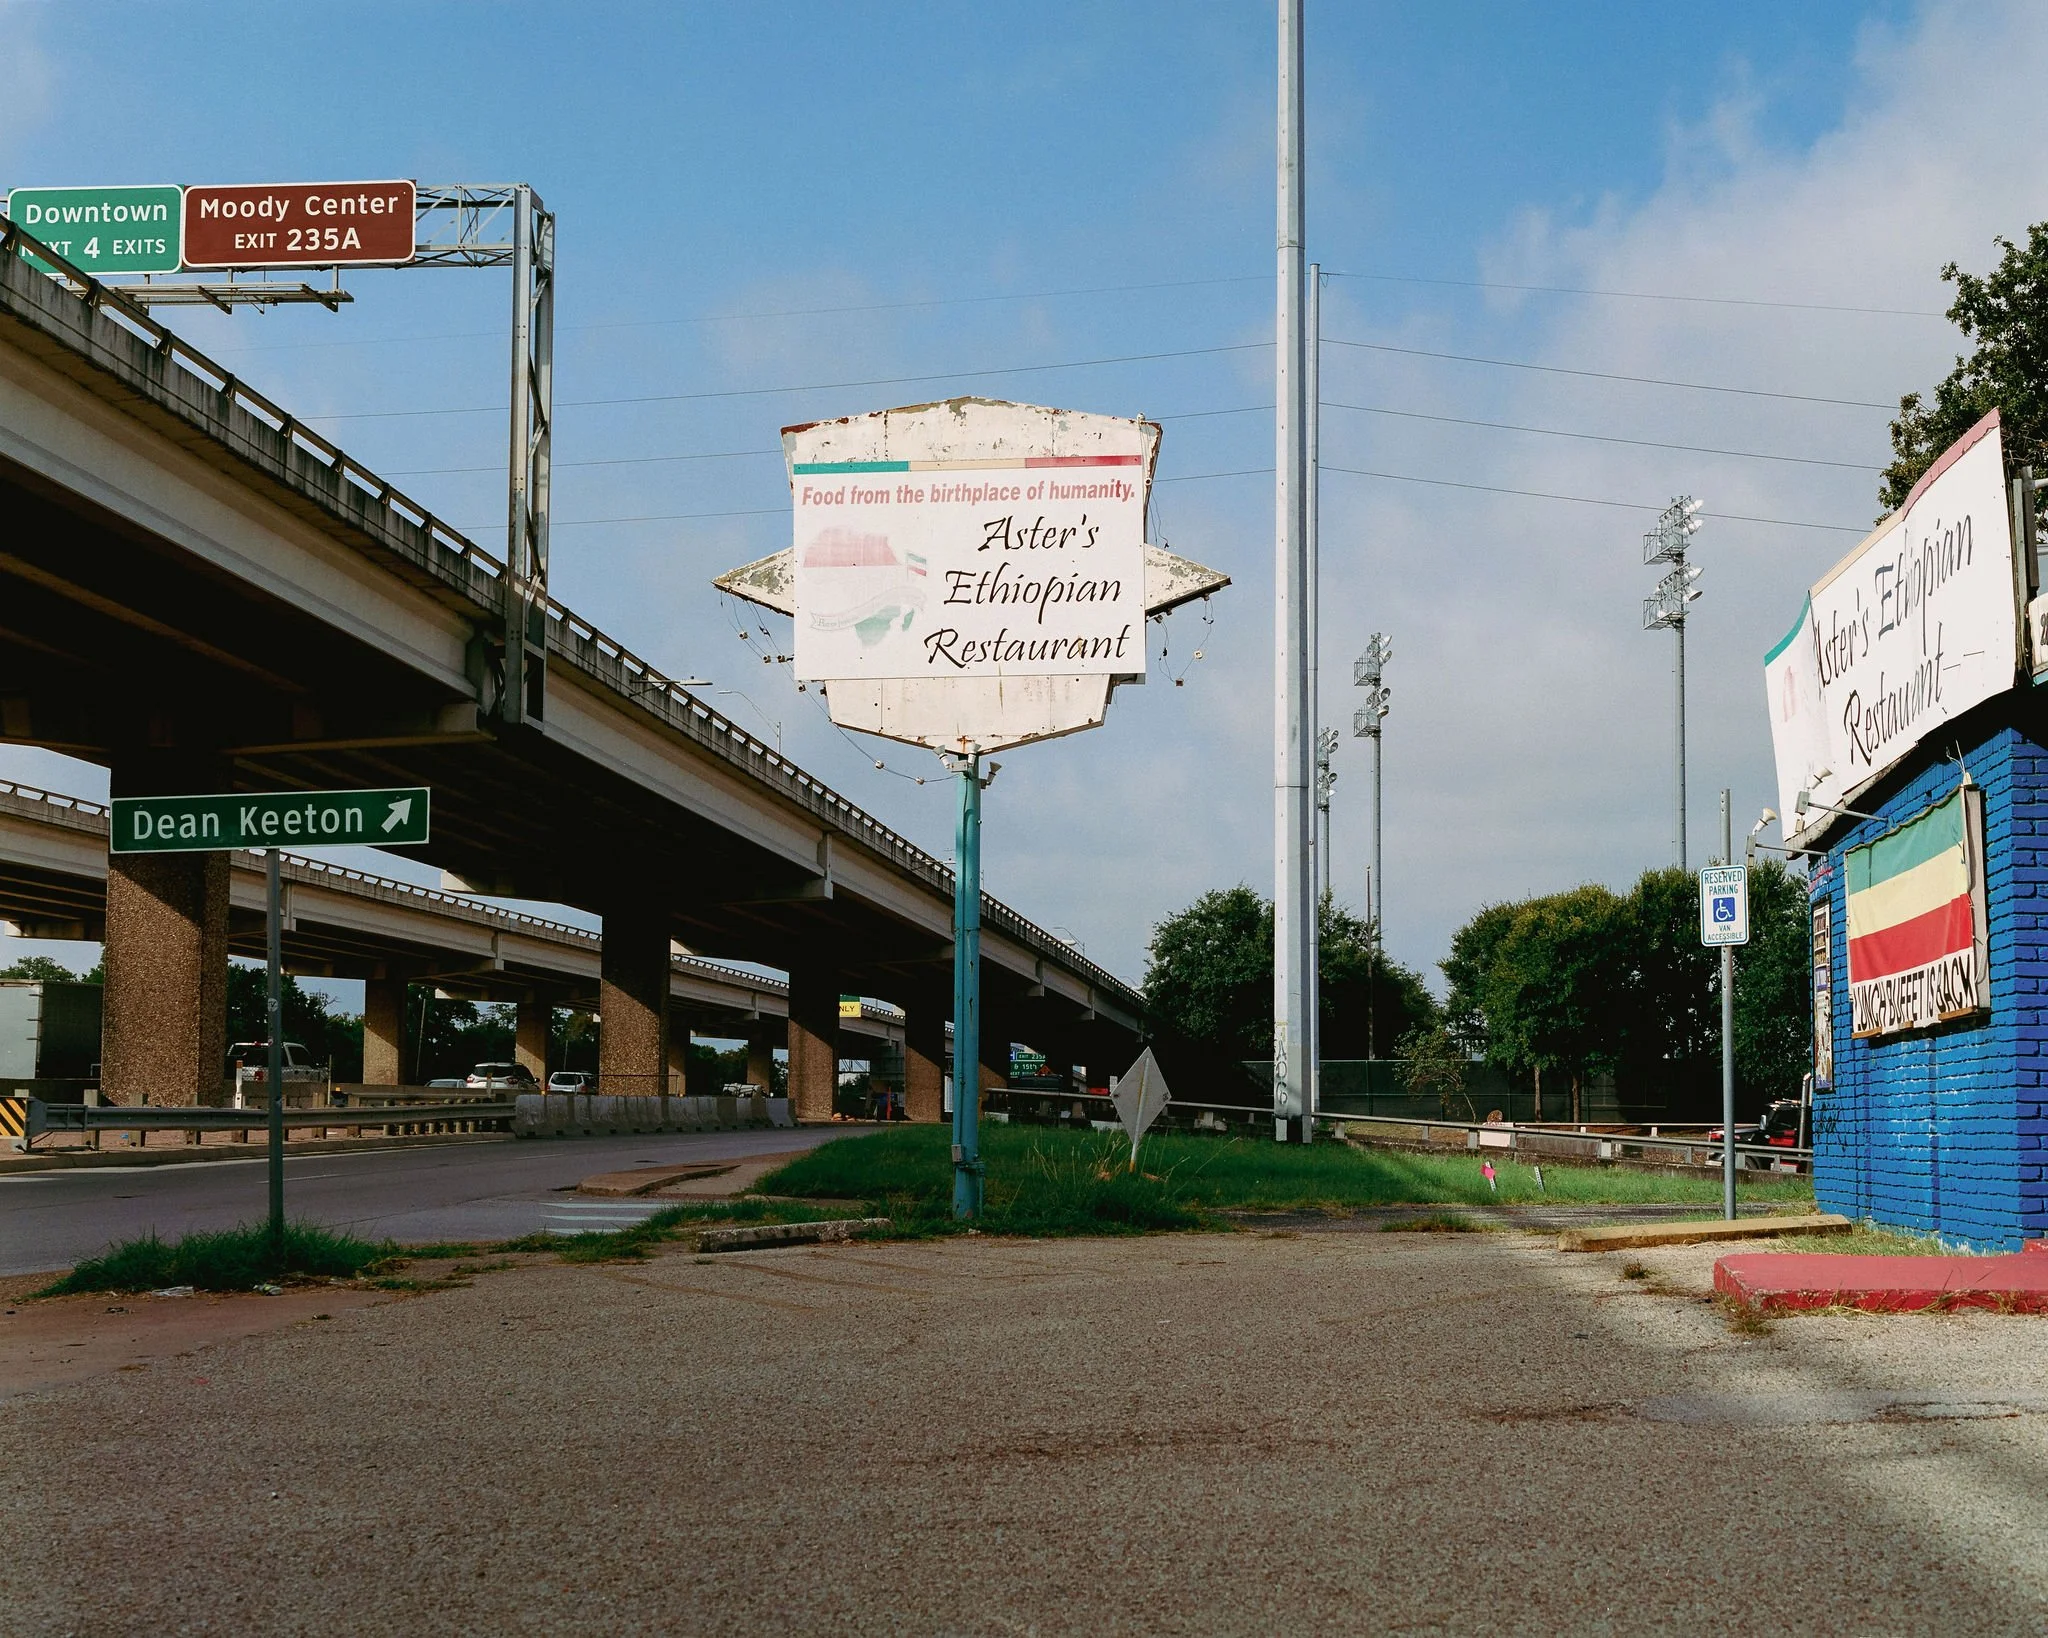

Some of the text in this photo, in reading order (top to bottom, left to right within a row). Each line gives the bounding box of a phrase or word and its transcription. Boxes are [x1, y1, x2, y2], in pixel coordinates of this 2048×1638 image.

[26, 202, 167, 224] Downtown
[200, 194, 398, 222] Moody Center
[21, 237, 166, 259] NXT 4 EXITS
[234, 227, 361, 251] EXIT 235A
[802, 479, 1135, 506] Food from the birthplace of humanity.
[977, 514, 1100, 552] Aster's
[943, 562, 1122, 623] Ethiopian
[923, 624, 1131, 668] Restaurant
[133, 803, 363, 840] Dean Keeton
[1704, 870, 1743, 884] RESERVED
[1709, 884, 1739, 895] PARKING
[1708, 932, 1743, 941] ACCESSIBLE
[1887, 970, 1925, 1026] BUFFET
[1927, 966, 1936, 1018] IS
